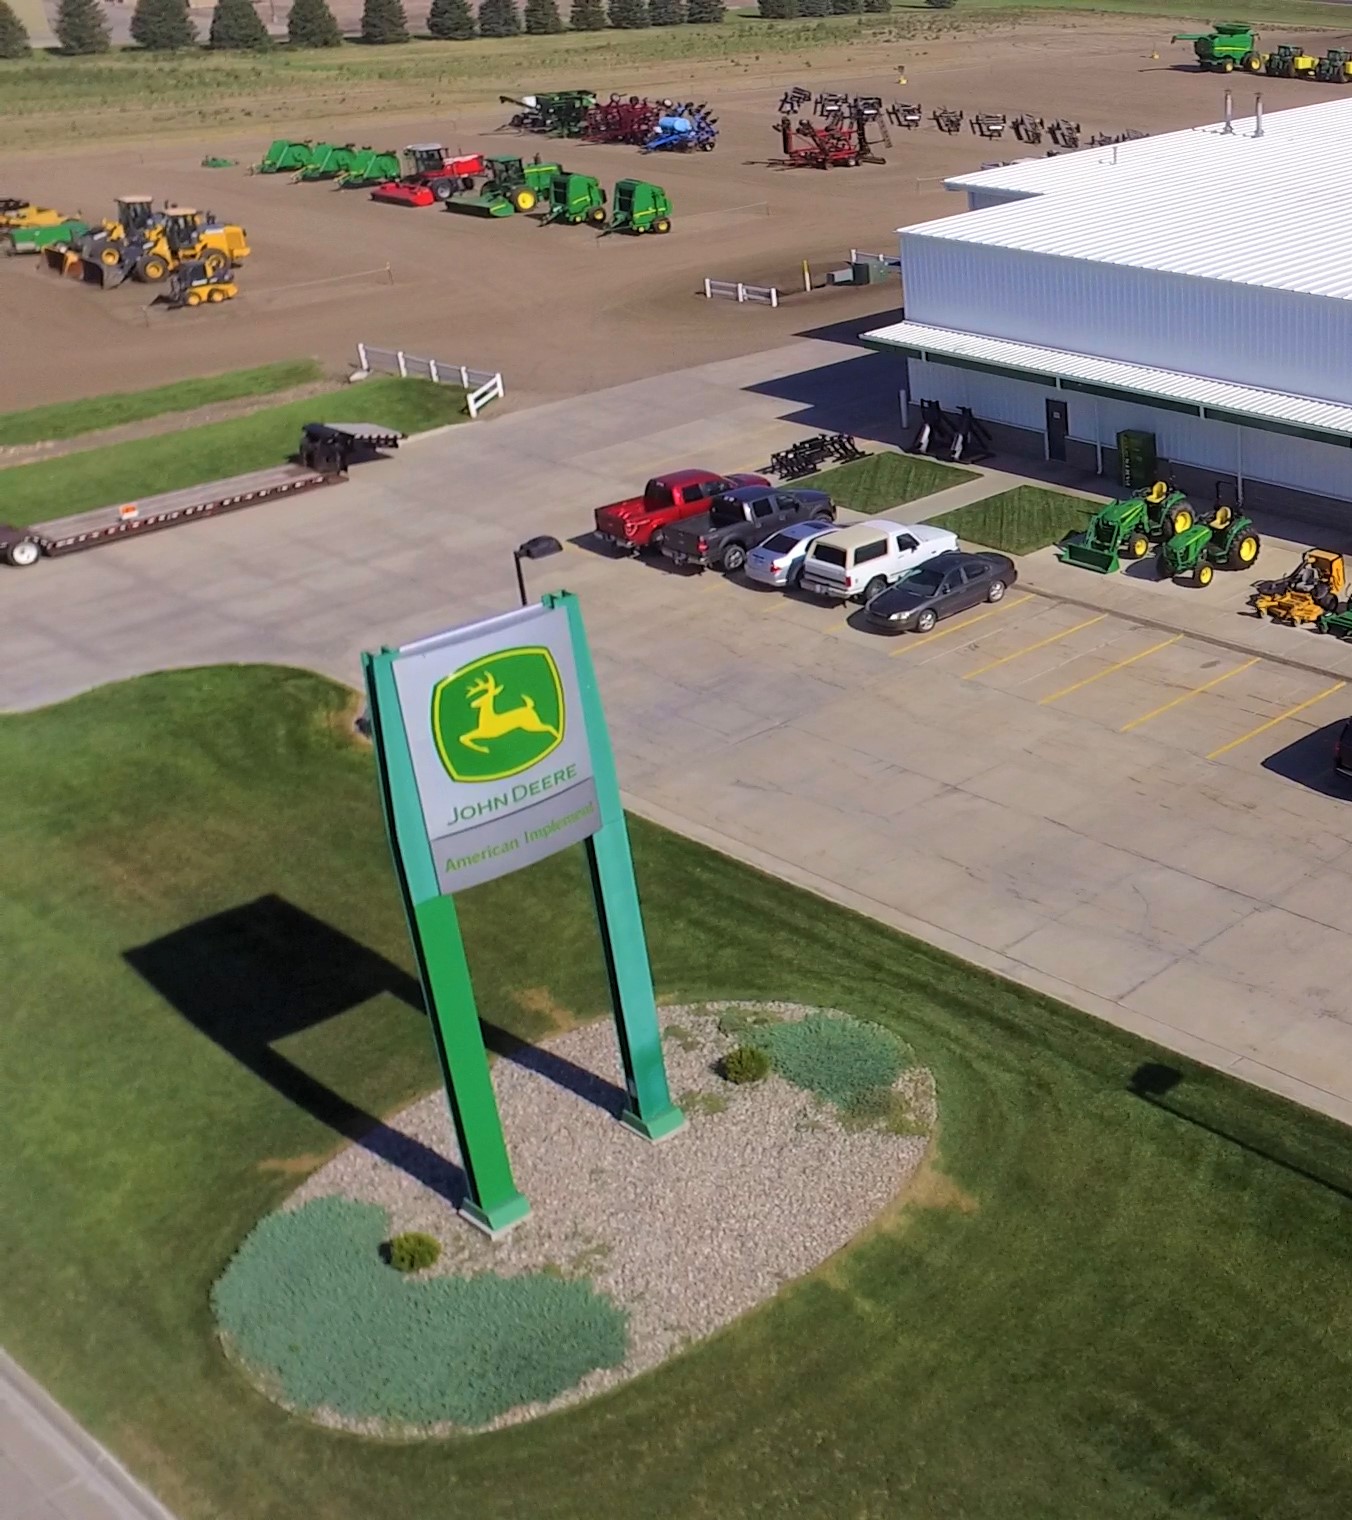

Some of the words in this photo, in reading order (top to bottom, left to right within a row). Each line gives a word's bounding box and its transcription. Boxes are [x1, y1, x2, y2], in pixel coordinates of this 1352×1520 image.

[447, 793, 508, 826] JOHN
[511, 763, 577, 802] DEERE
[446, 838, 519, 873] American
[524, 801, 594, 843] Implement
